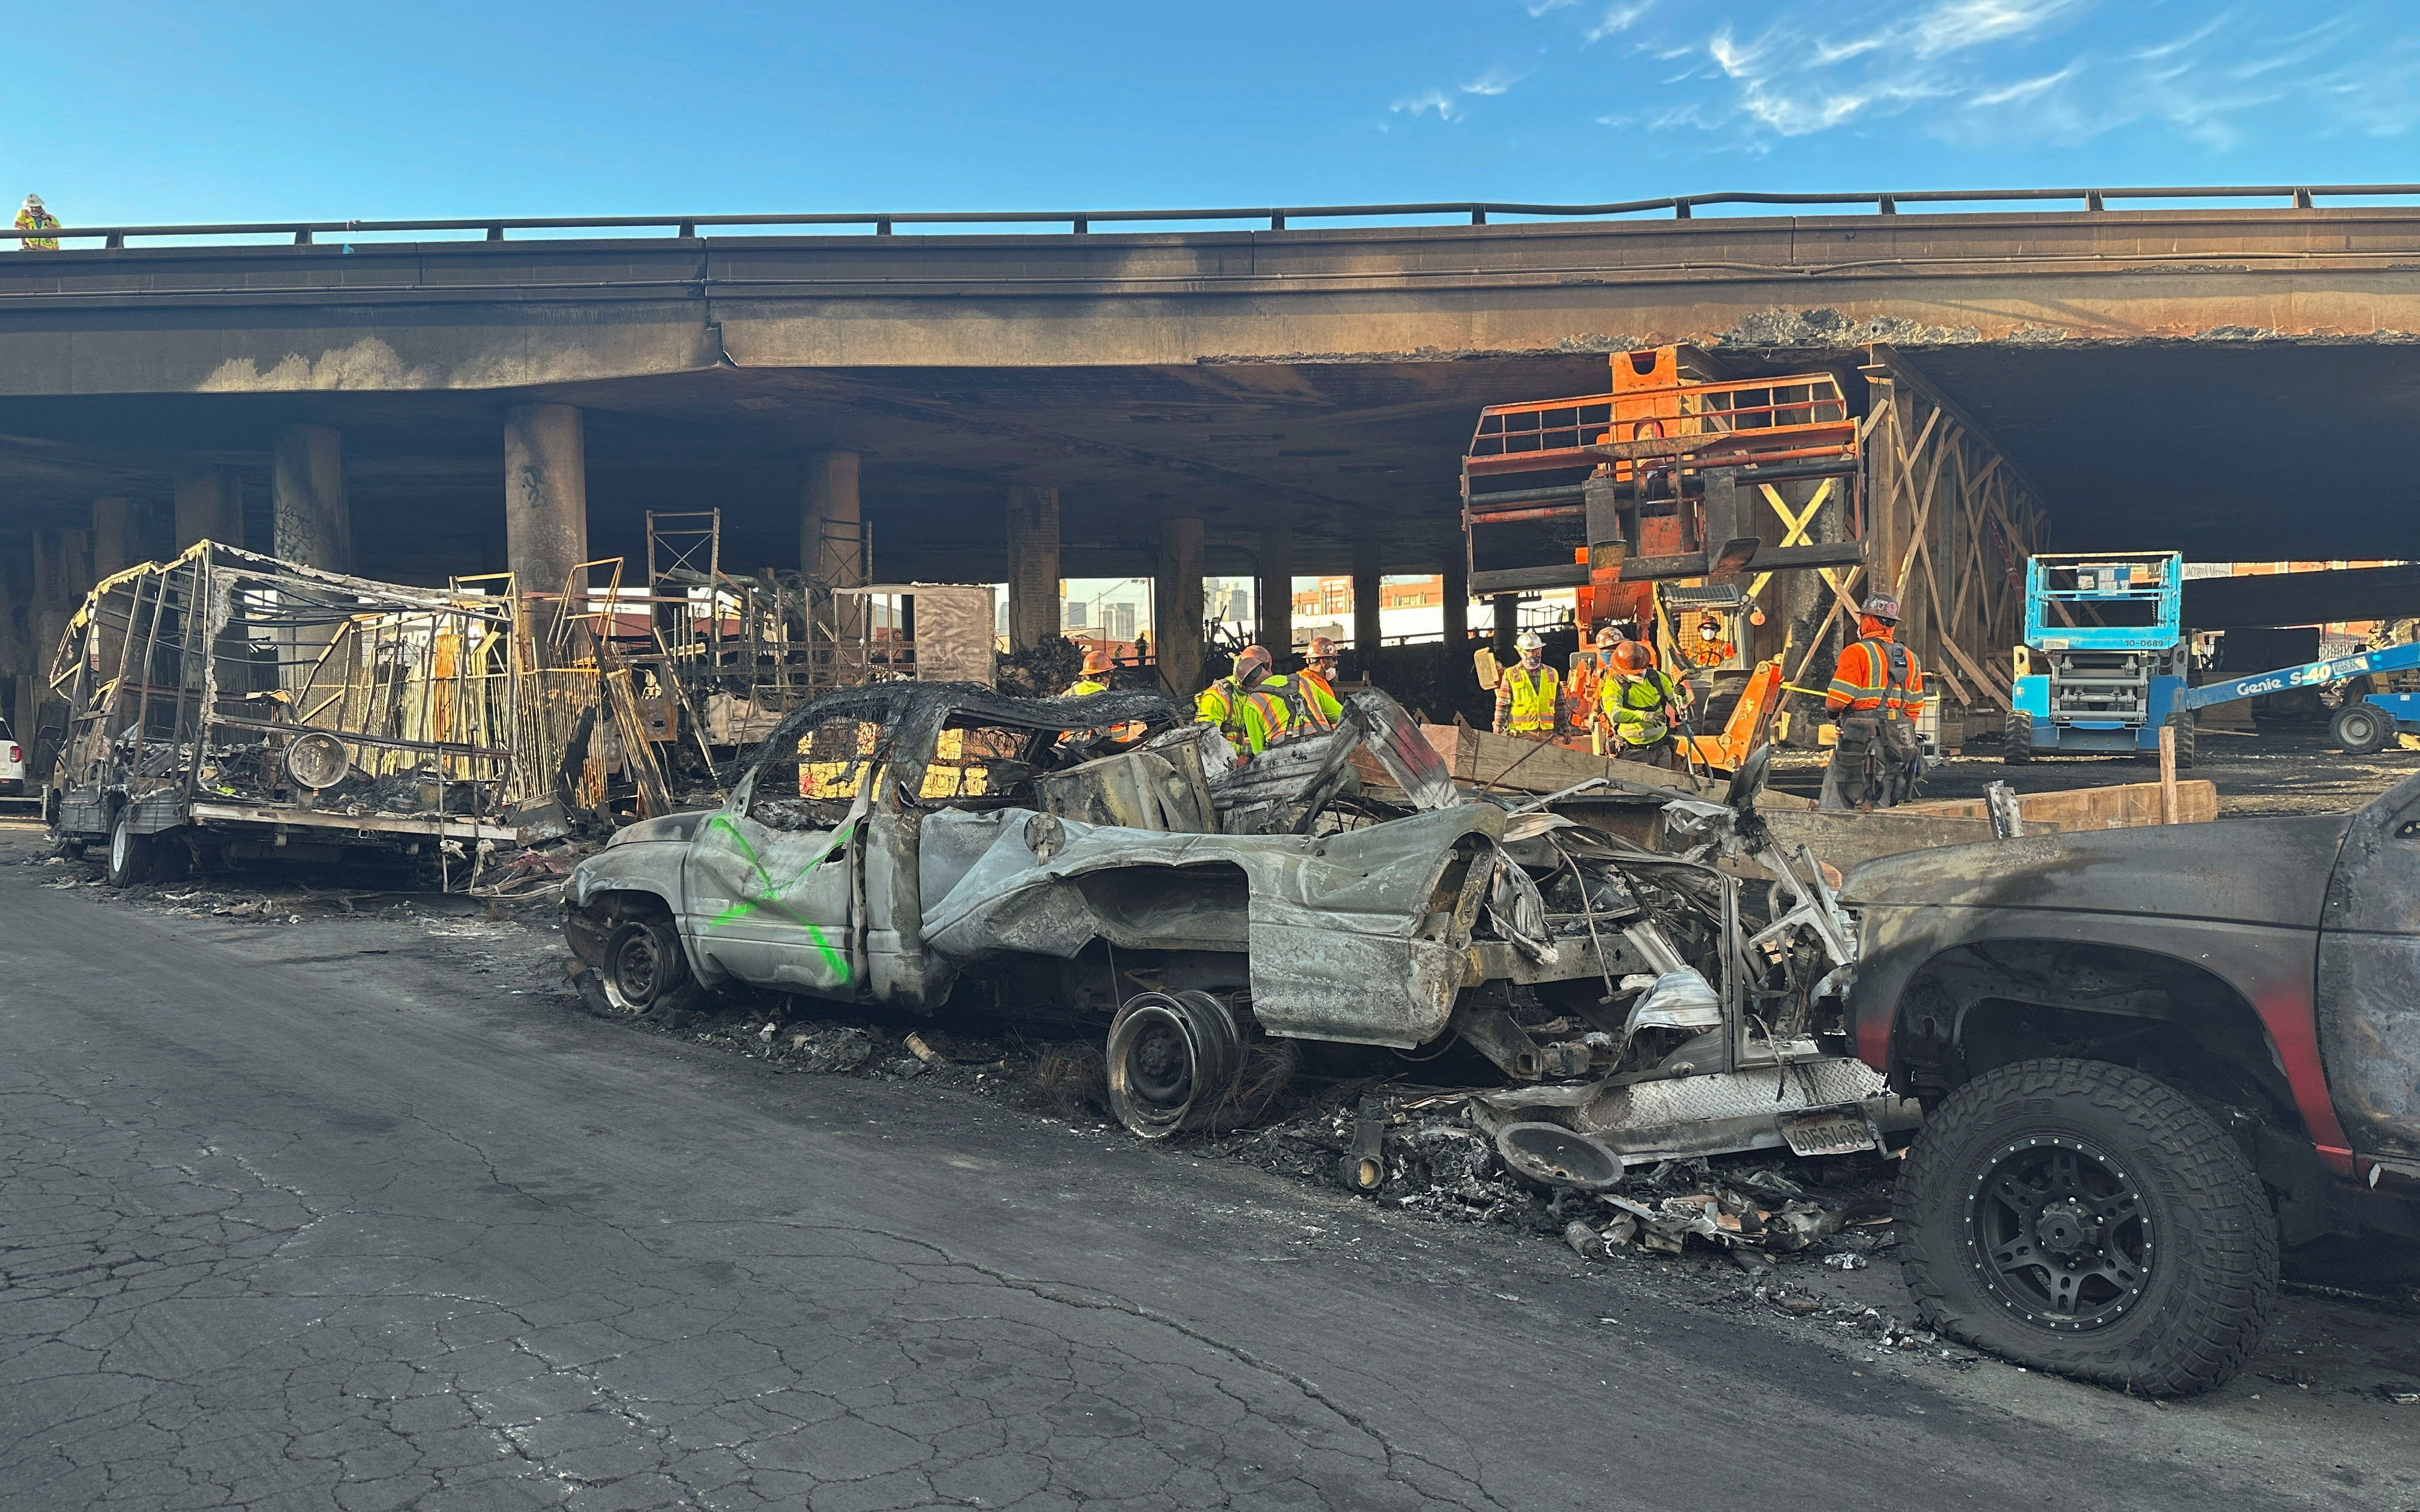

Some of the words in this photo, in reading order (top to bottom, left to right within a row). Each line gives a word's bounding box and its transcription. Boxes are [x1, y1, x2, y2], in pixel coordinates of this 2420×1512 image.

[2236, 678, 2281, 696] Genie
[2289, 665, 2331, 685] S-40
[1796, 1113, 1840, 1127] California
